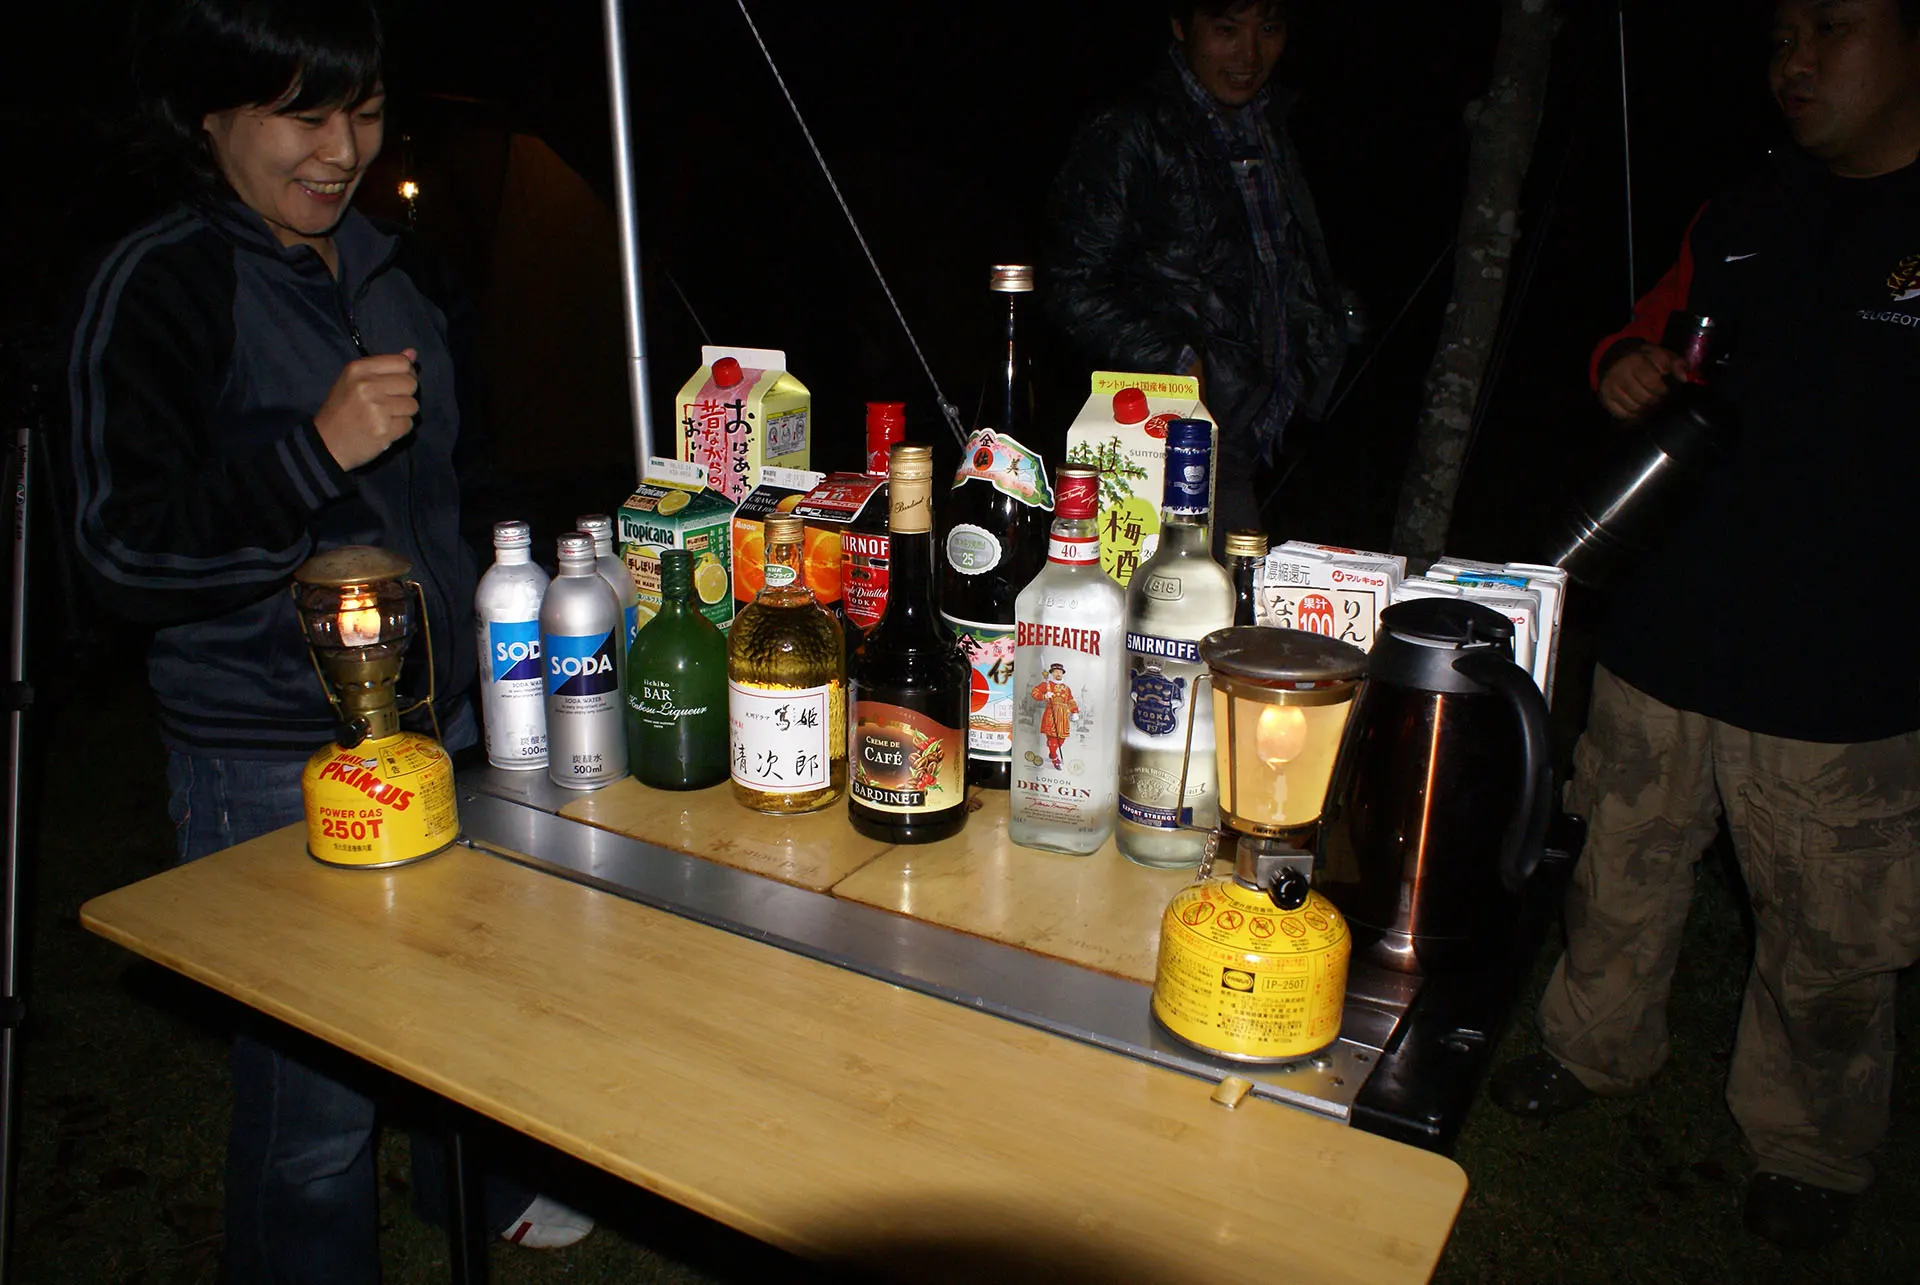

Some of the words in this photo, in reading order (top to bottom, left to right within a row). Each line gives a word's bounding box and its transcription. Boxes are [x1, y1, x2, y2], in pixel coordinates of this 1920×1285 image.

[700, 399, 726, 486] 昔ながらの
[724, 399, 755, 504] おばあちゃ
[620, 514, 675, 546] Tropicana
[1102, 510, 1146, 580] 梅酒
[962, 552, 974, 566] 25
[1345, 573, 1384, 587] マルキョウ
[1303, 597, 1328, 610] 果汁
[1338, 598, 1367, 643] りん
[1017, 620, 1101, 657] BEEFEATER
[551, 654, 614, 677] SODA
[643, 687, 673, 701] BAR
[1137, 709, 1171, 721] VODKA
[891, 741, 900, 749] DE
[864, 746, 903, 766] CAFÉ
[573, 764, 603, 774] 500ml
[318, 761, 416, 812] PRIMUS
[1017, 779, 1052, 794] DRY
[1057, 785, 1092, 799] GIN
[1036, 775, 1072, 786] LONDON
[854, 782, 920, 804] BARDINET
[319, 807, 355, 819] POWER
[359, 808, 383, 819] GAS
[321, 818, 384, 841] 250T
